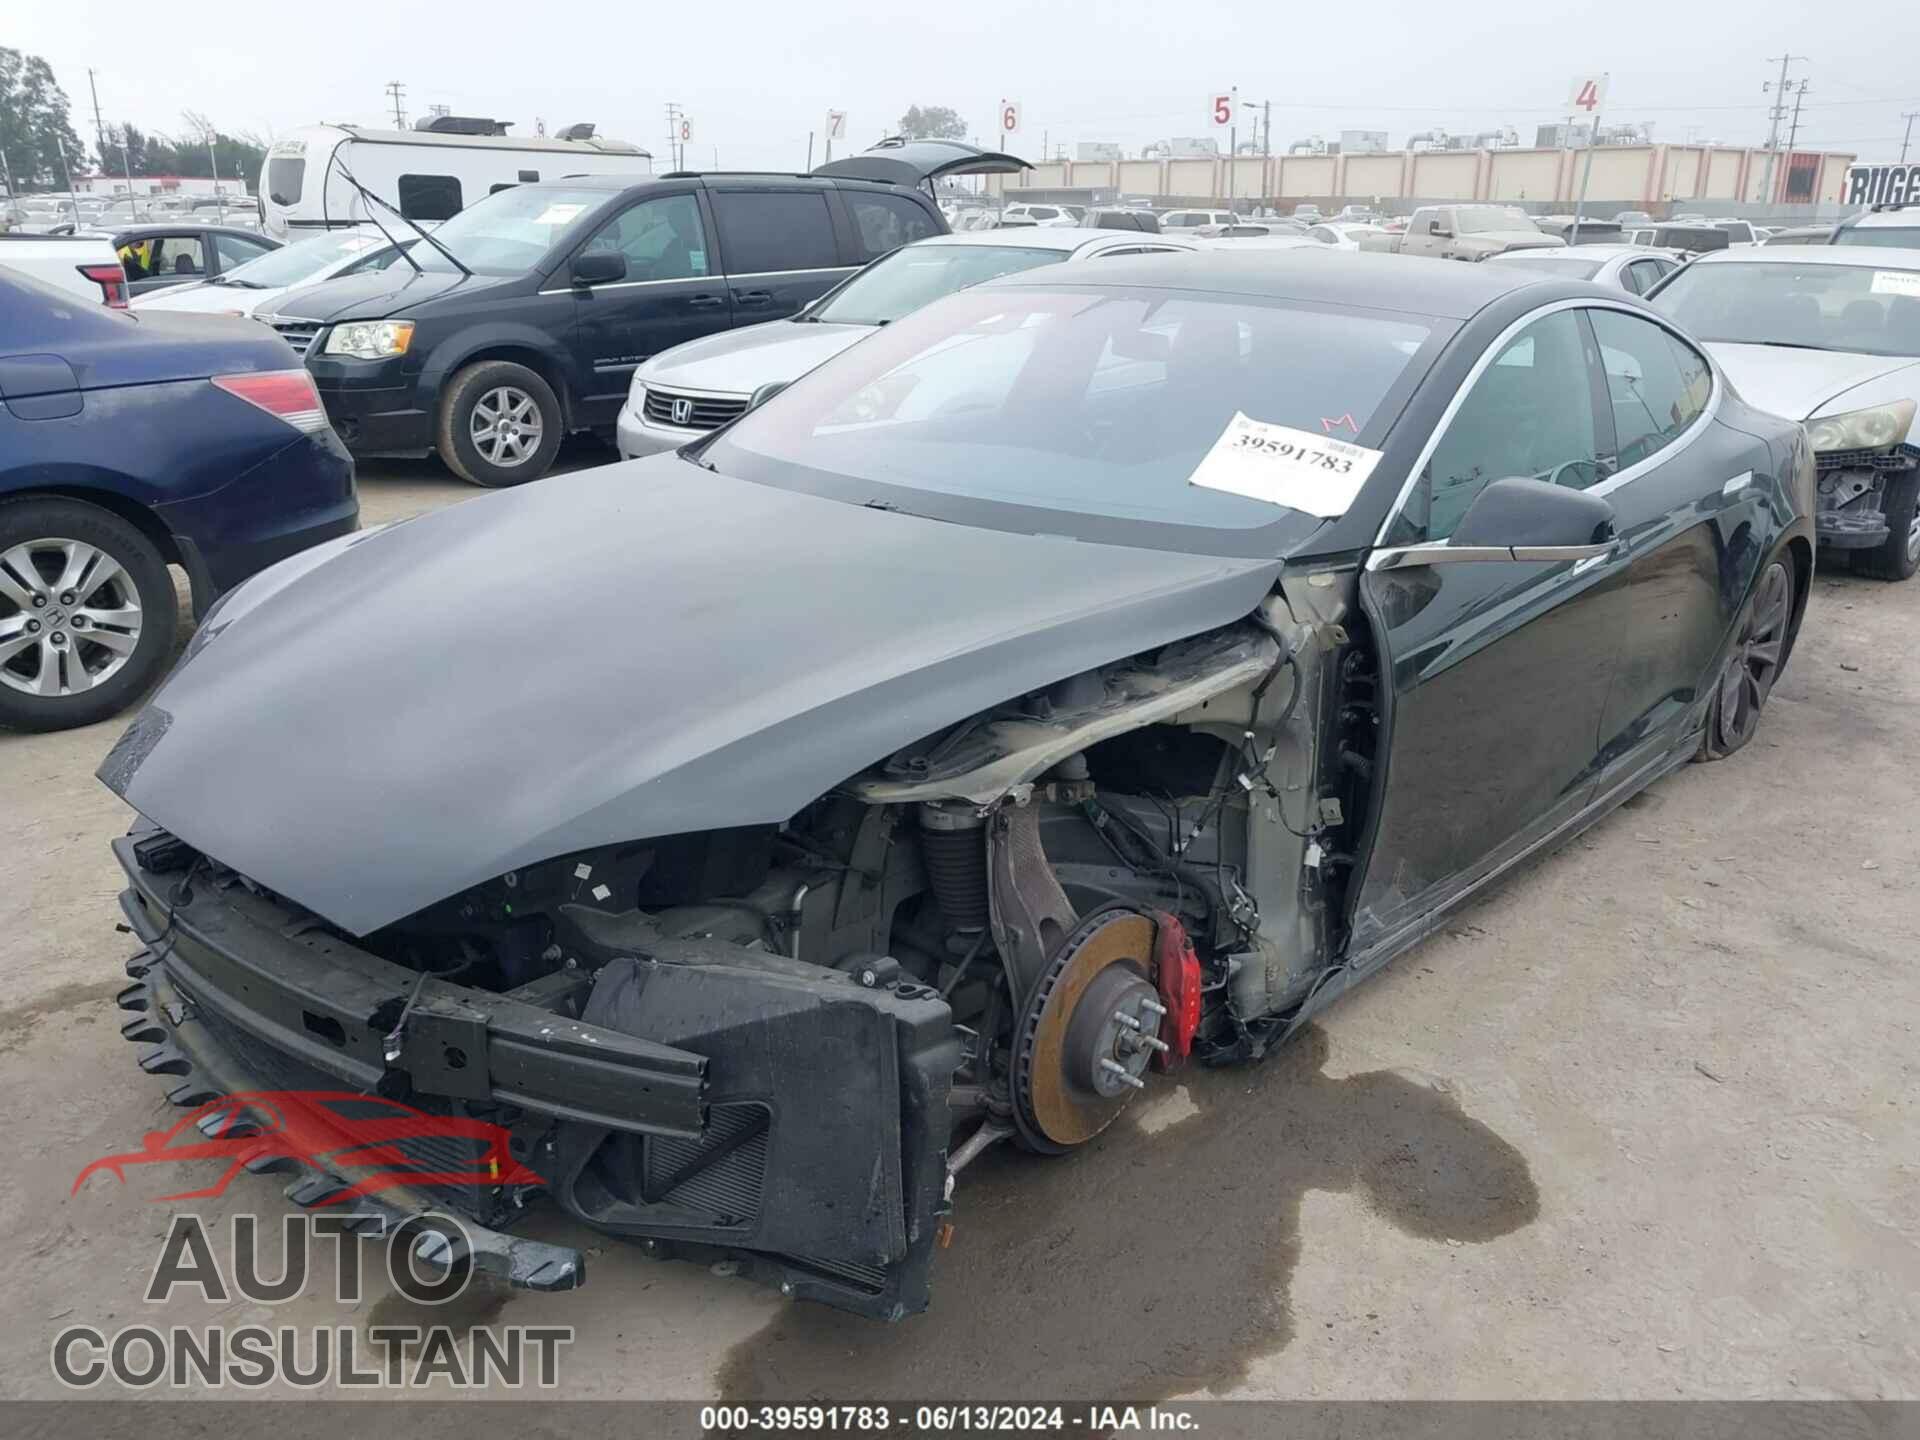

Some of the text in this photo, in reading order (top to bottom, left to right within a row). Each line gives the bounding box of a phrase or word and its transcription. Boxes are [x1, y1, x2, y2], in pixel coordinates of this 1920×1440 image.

[1575, 80, 1597, 111] 4
[1003, 106, 1016, 130] 6
[1214, 96, 1230, 124] 5
[681, 120, 690, 140] 8
[830, 114, 842, 136] 7
[1232, 434, 1354, 474] 39591783
